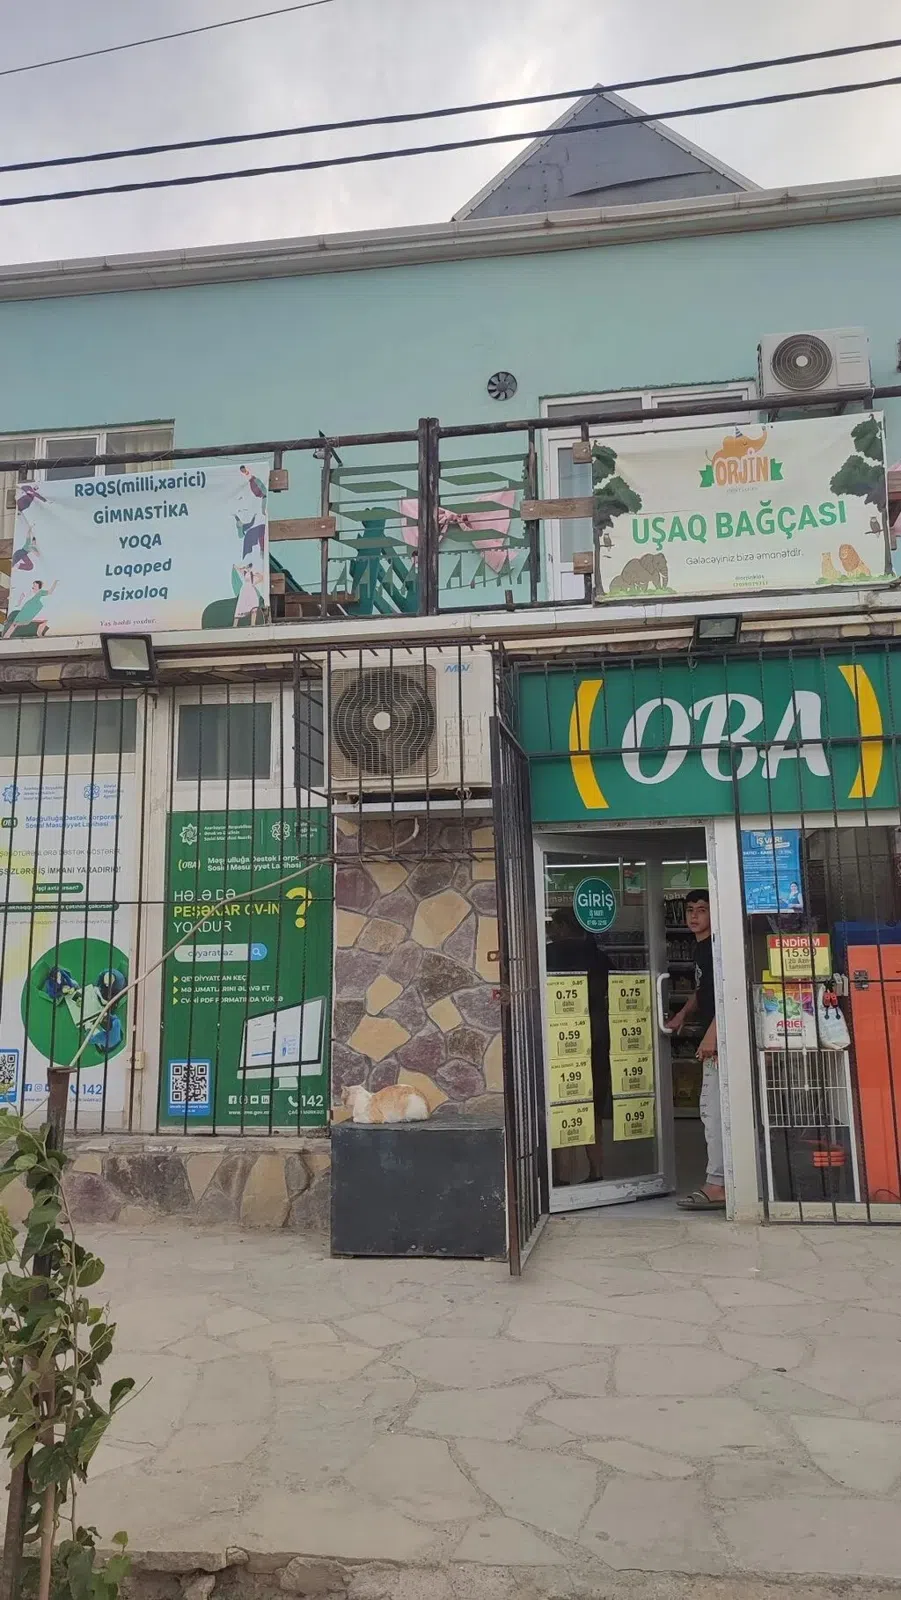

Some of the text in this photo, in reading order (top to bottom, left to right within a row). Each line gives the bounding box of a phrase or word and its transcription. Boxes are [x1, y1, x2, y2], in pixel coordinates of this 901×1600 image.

[93, 501, 189, 524] GİMNASTİKA
[632, 500, 846, 550] UŞAQ BAĞÇASI
[119, 533, 162, 549] YOQA
[685, 552, 736, 566] Gələcəyiniz
[737, 552, 754, 562] bizə
[105, 558, 172, 578] Loqoped
[103, 585, 169, 602] Psixoloq
[578, 890, 614, 911] GİRİŞ
[556, 989, 578, 1000] 0.75
[620, 988, 641, 998] 0.75
[558, 1030, 580, 1041] 0.59
[621, 1026, 642, 1037] 0.39
[560, 1071, 582, 1082] 1.99
[623, 1066, 643, 1077] 1.99
[82, 1084, 102, 1095] 142
[301, 1095, 324, 1107] 142
[625, 1111, 645, 1122] 0.99
[561, 1117, 583, 1129] 0.39
